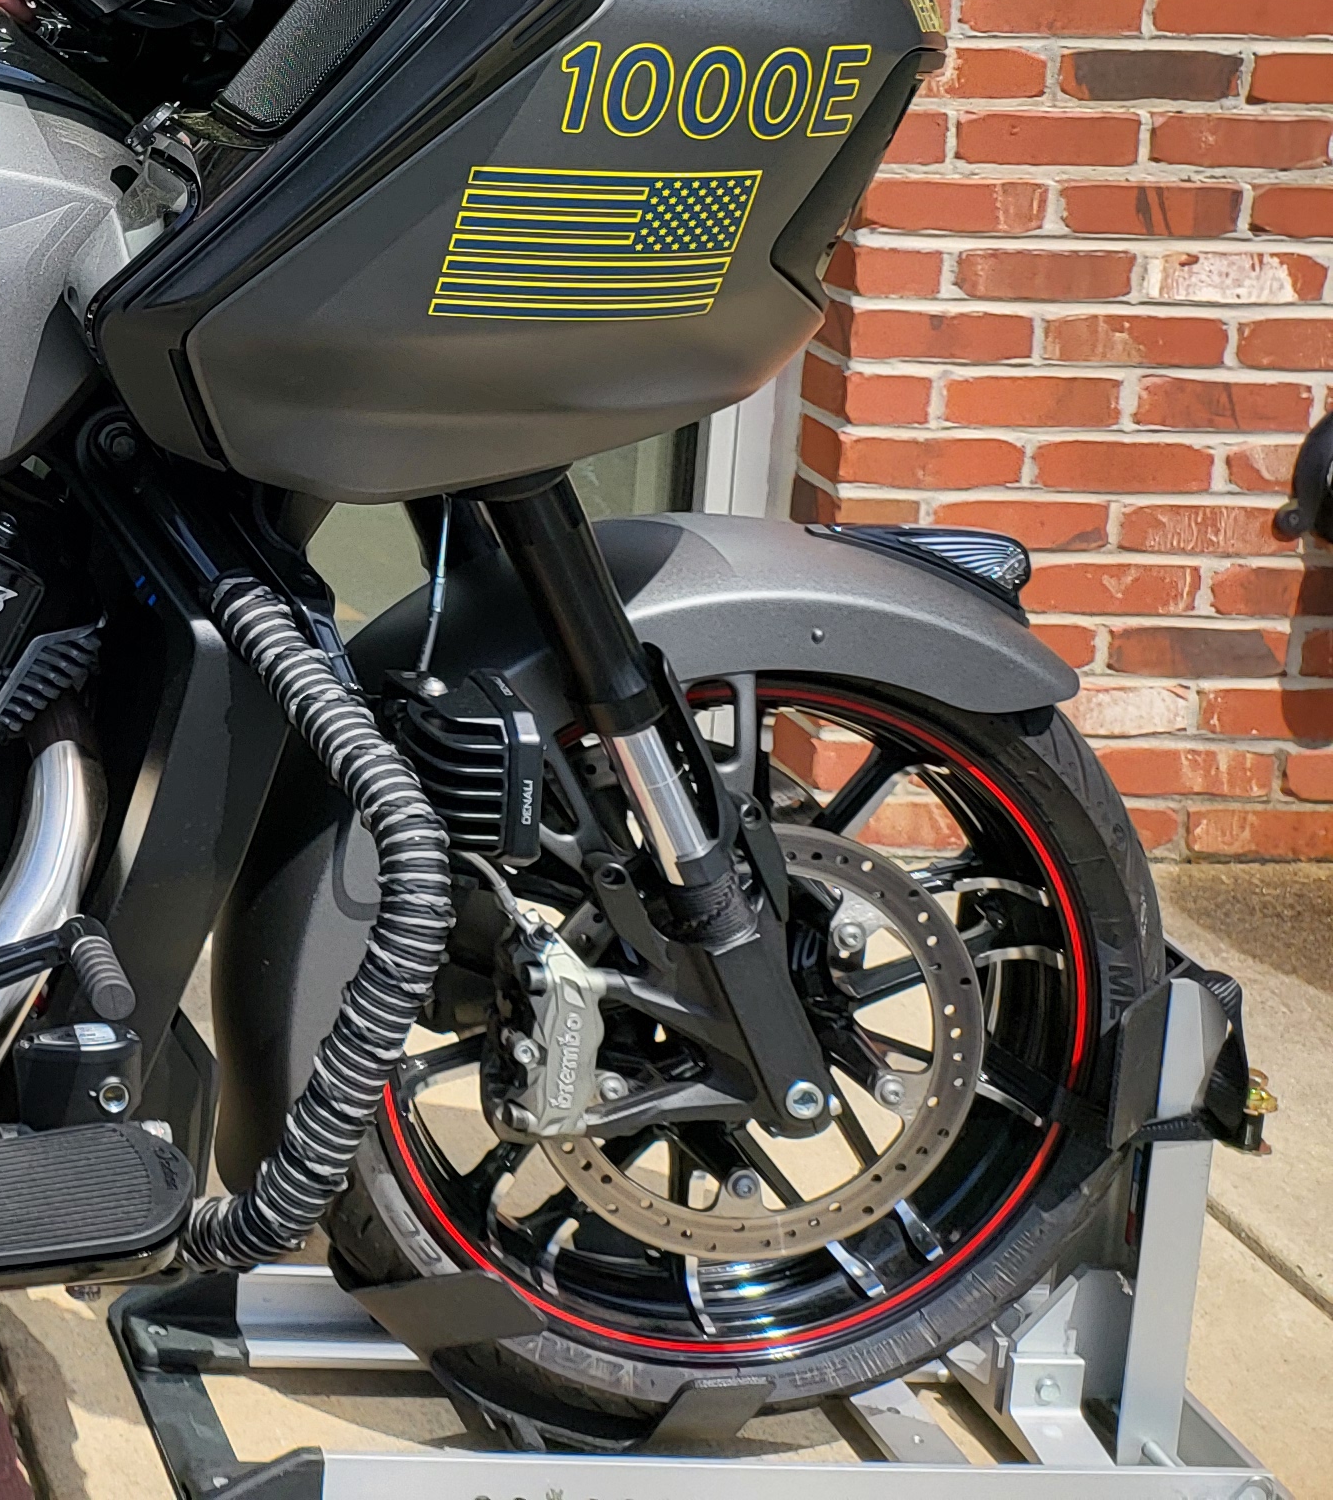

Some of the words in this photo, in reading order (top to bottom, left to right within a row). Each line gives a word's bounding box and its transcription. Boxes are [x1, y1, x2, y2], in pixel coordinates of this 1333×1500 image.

[561, 41, 872, 140] 1000E
[521, 779, 534, 825] DENALI
[548, 1012, 583, 1110] brembo
